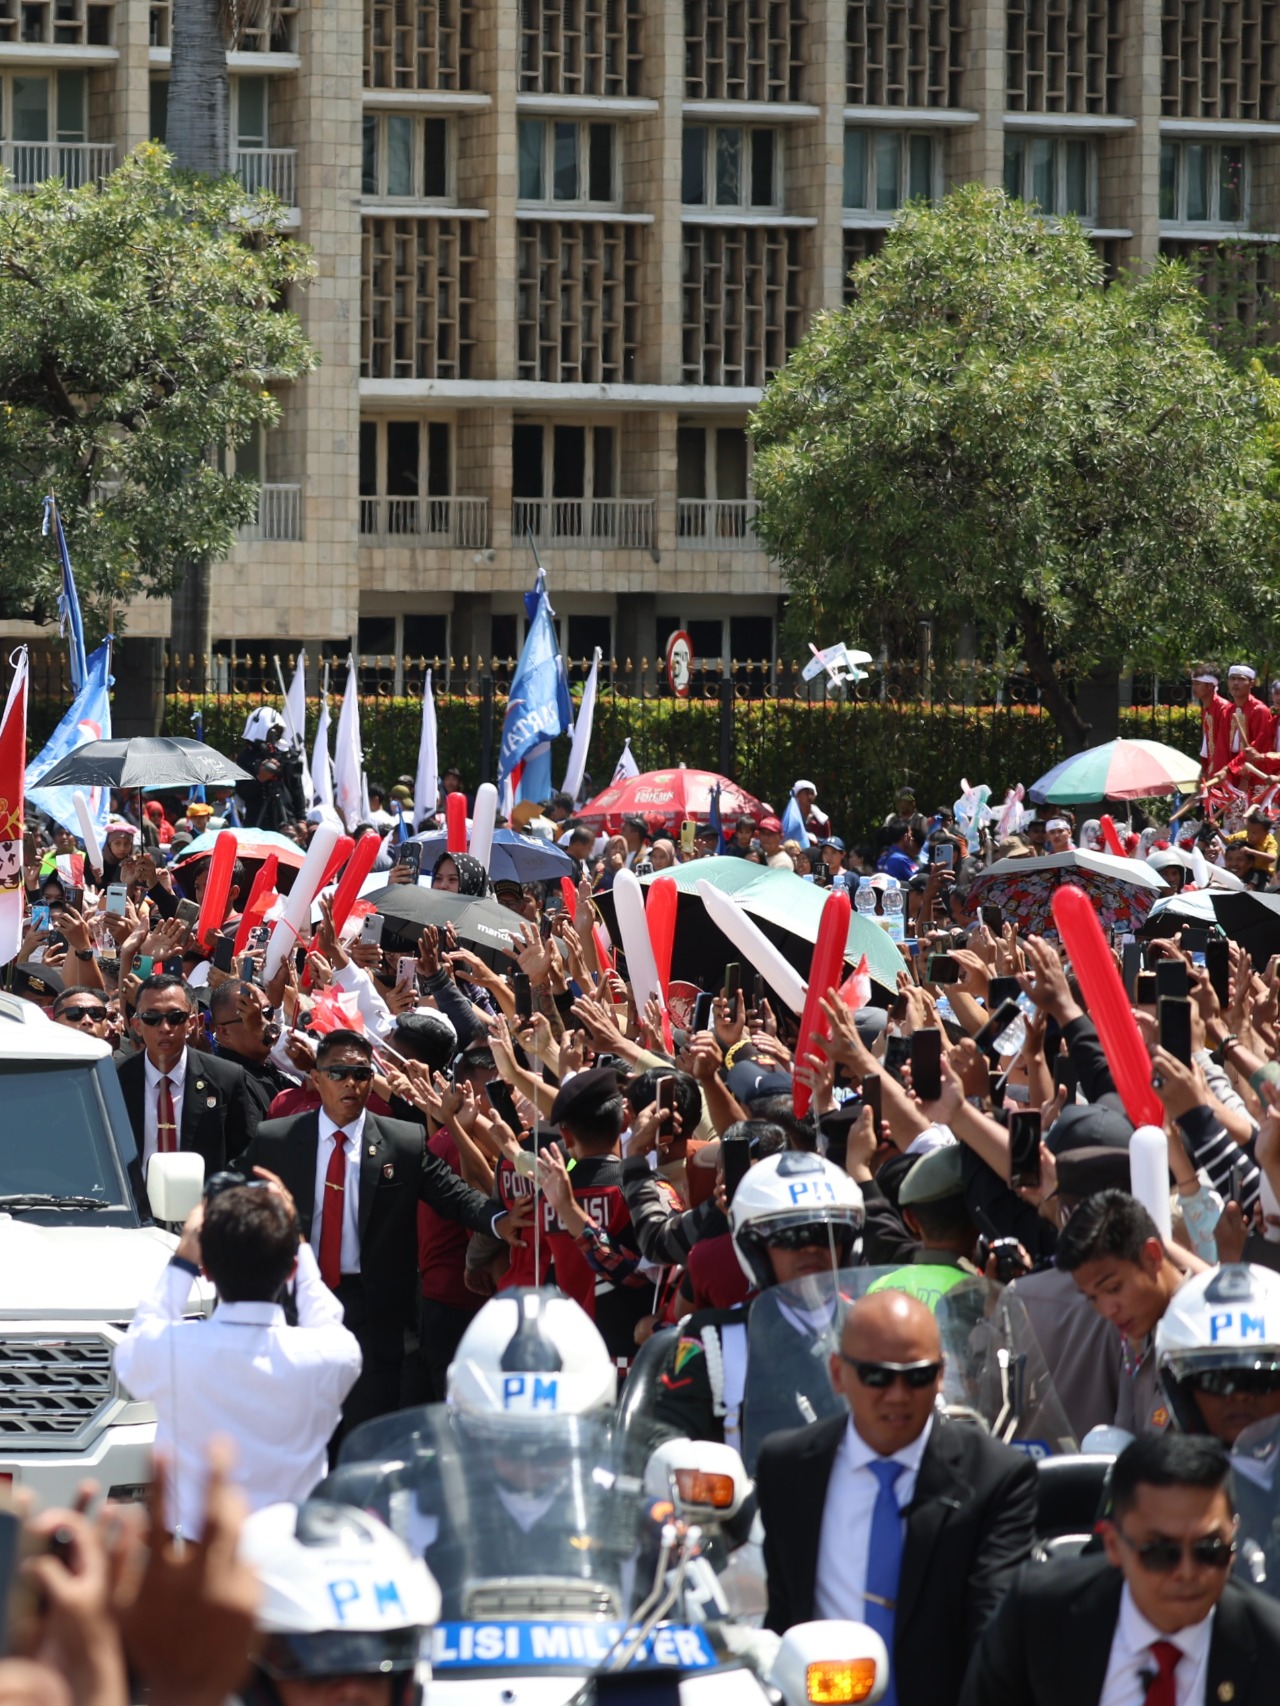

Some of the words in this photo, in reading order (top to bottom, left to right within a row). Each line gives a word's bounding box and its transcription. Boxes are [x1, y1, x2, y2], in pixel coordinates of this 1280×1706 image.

[1210, 1312, 1266, 1344] PM
[503, 1376, 558, 1410] PM
[328, 1578, 407, 1620] PM
